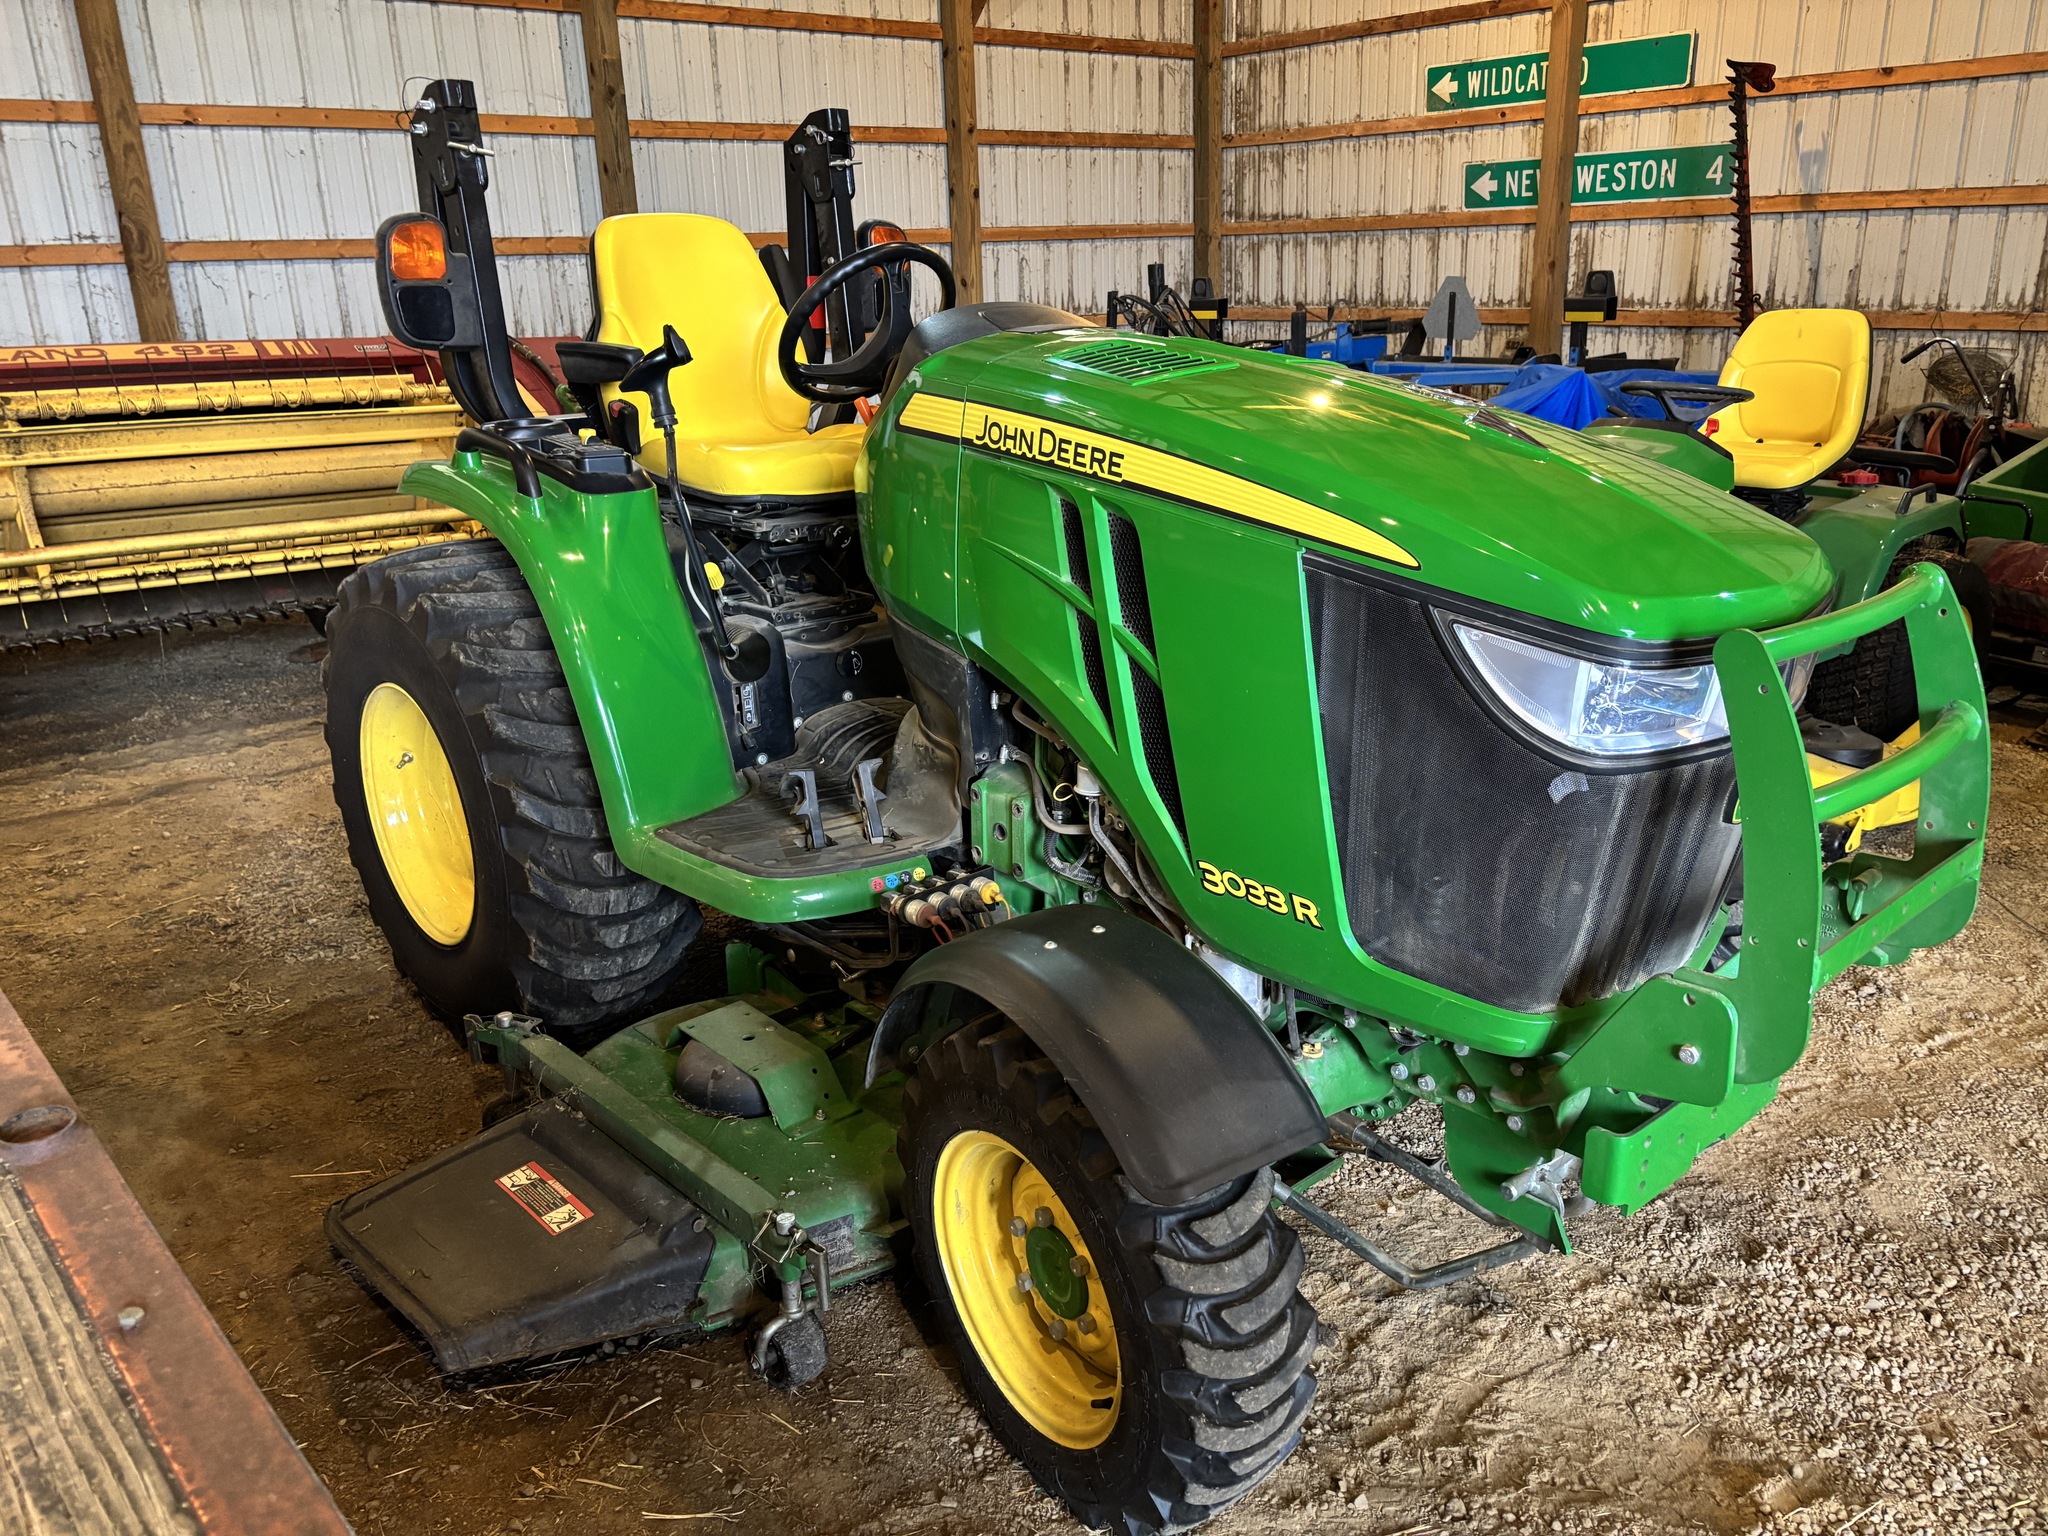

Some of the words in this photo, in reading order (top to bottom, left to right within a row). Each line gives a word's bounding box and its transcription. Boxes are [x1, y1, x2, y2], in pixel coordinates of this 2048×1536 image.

[1467, 61, 1549, 98] WILDCAT
[1505, 168, 1541, 198] NE
[1576, 158, 1677, 194] WESTON
[1705, 155, 1724, 186] 4
[0, 348, 108, 362] AND
[134, 344, 239, 356] 492
[975, 414, 1035, 455] JOHN
[1038, 427, 1125, 479] DEERE
